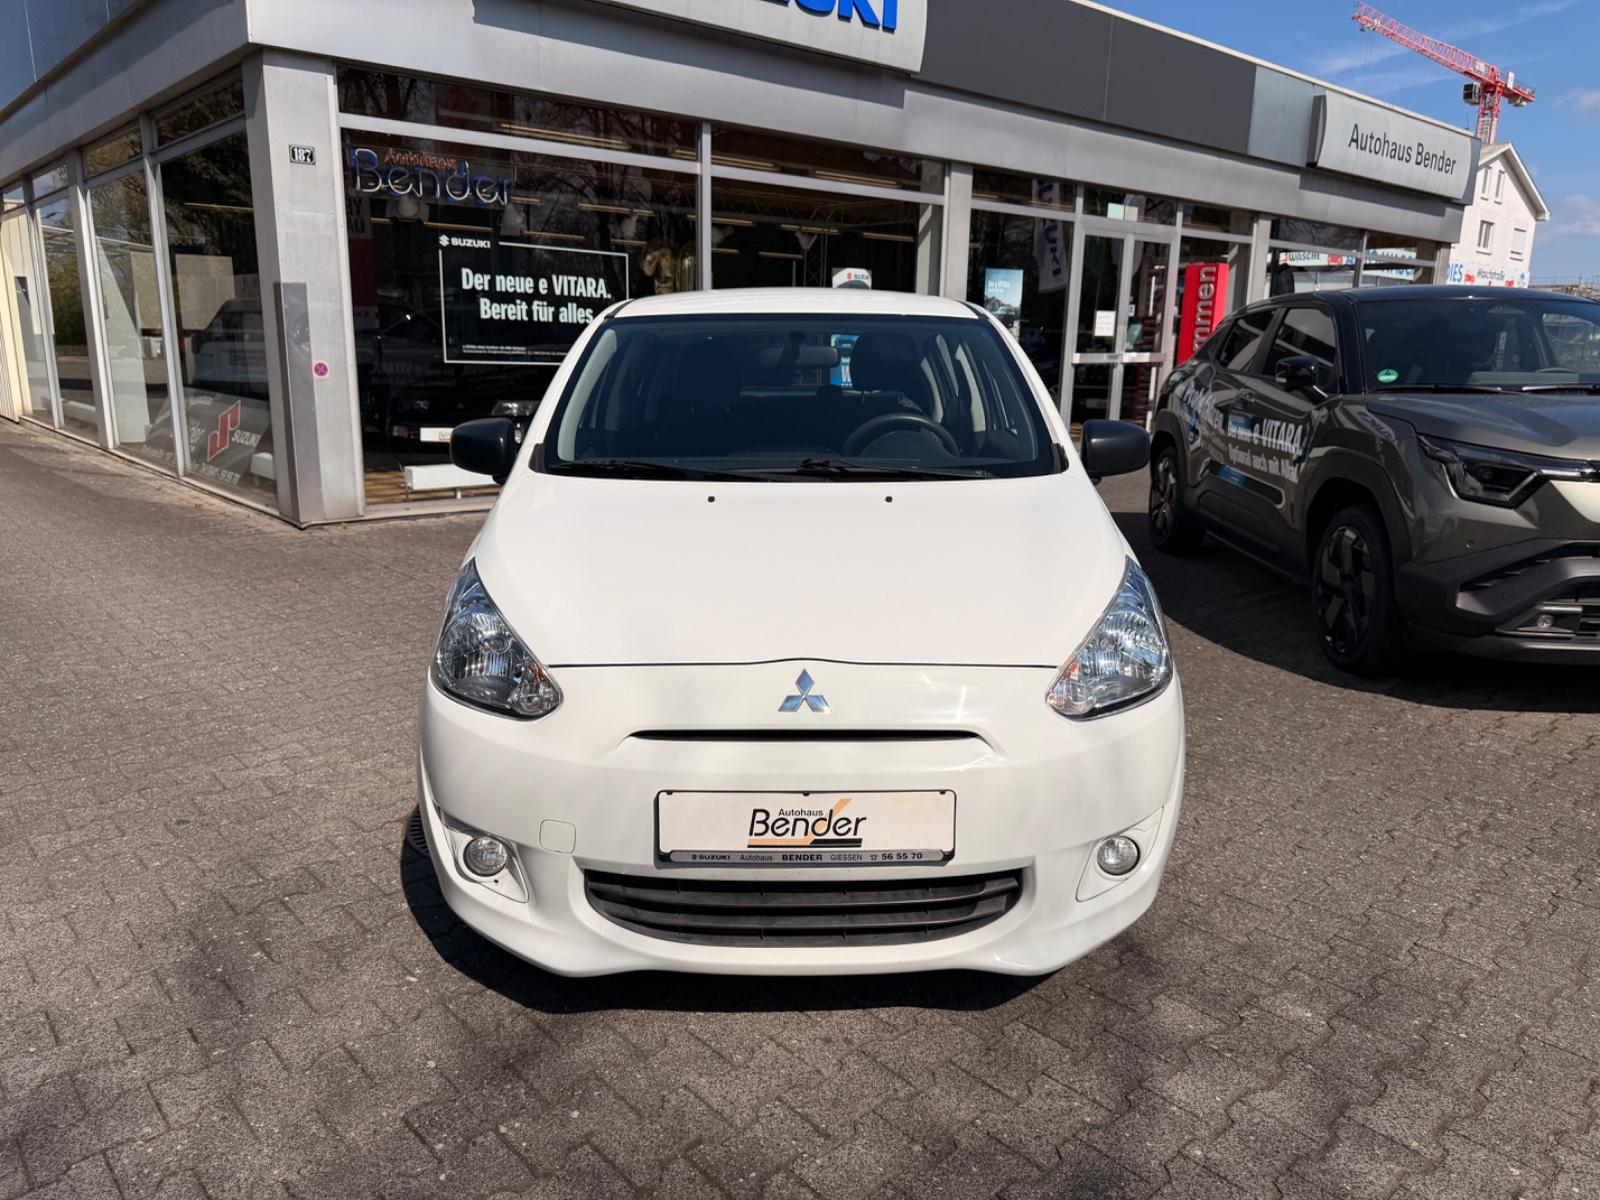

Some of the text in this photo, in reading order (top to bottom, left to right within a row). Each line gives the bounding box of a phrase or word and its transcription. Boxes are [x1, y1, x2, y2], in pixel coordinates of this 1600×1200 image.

[292, 148, 313, 163] 187
[1348, 123, 1457, 175] Autohaus Bender
[352, 148, 512, 205] Bender
[451, 237, 491, 248] SUZUKI
[461, 267, 612, 299] Der neue e VITARA.
[479, 297, 595, 324] Bereit für alles
[749, 808, 867, 837] Bender
[778, 808, 823, 817] Autohaus
[740, 854, 773, 862] Autohaus
[782, 853, 823, 861] BENDER
[830, 853, 863, 861] GIESSEN
[881, 852, 893, 860] 56
[896, 852, 908, 860] 55
[911, 851, 923, 860] 70
